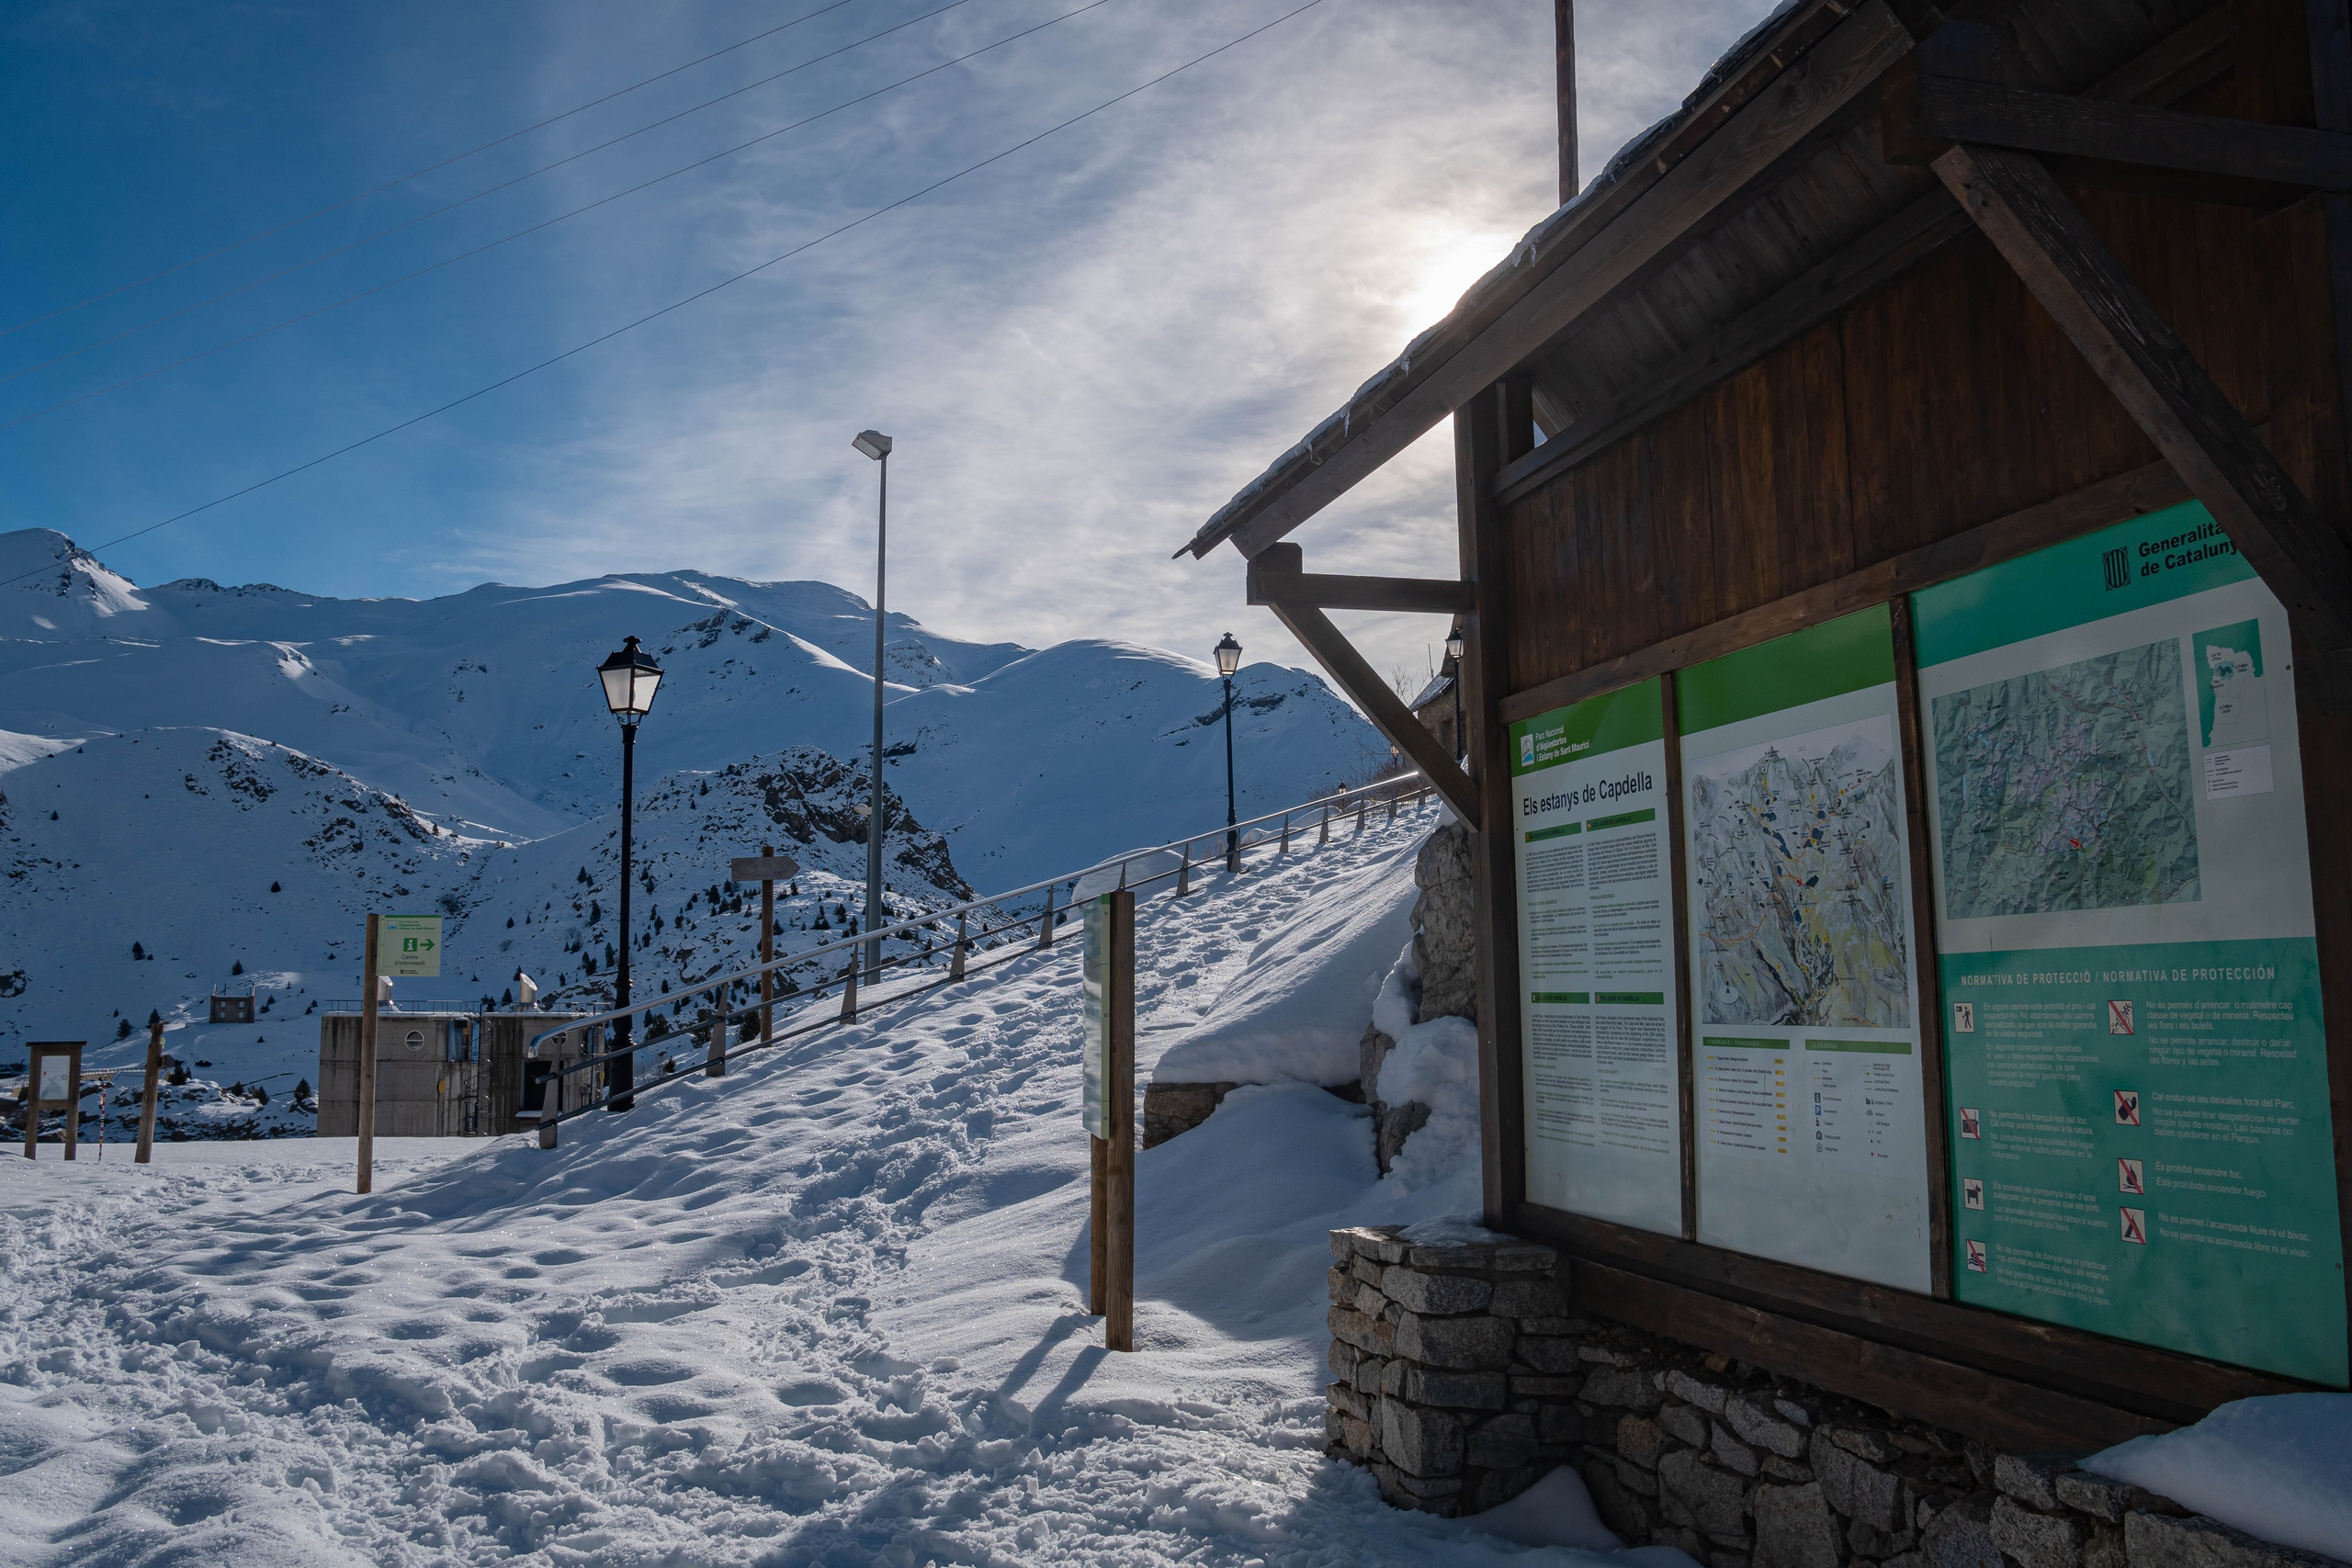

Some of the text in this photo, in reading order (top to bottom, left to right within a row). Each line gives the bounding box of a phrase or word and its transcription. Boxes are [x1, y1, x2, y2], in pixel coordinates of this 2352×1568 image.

[2139, 522, 2225, 558] Generalita
[2141, 540, 2238, 577] de Cataluny
[1535, 725, 1564, 741] Parc Nacional
[1539, 750, 1553, 762] Estany
[1560, 746, 1571, 756] Sant
[1571, 739, 1589, 753] Maurici
[1523, 771, 1653, 816] Els estanys de Capdella
[1961, 974, 2013, 986] NORMATIVA
[2017, 973, 2030, 985] DE
[2032, 969, 2090, 984] PROTECCIÓ
[2103, 969, 2167, 983] NORMATIVA
[2172, 969, 2187, 981] DE
[2192, 964, 2275, 980] PROTECCIÓN
[2179, 1012, 2204, 1021] vegetal
[2253, 1012, 2294, 1021] Respecteu
